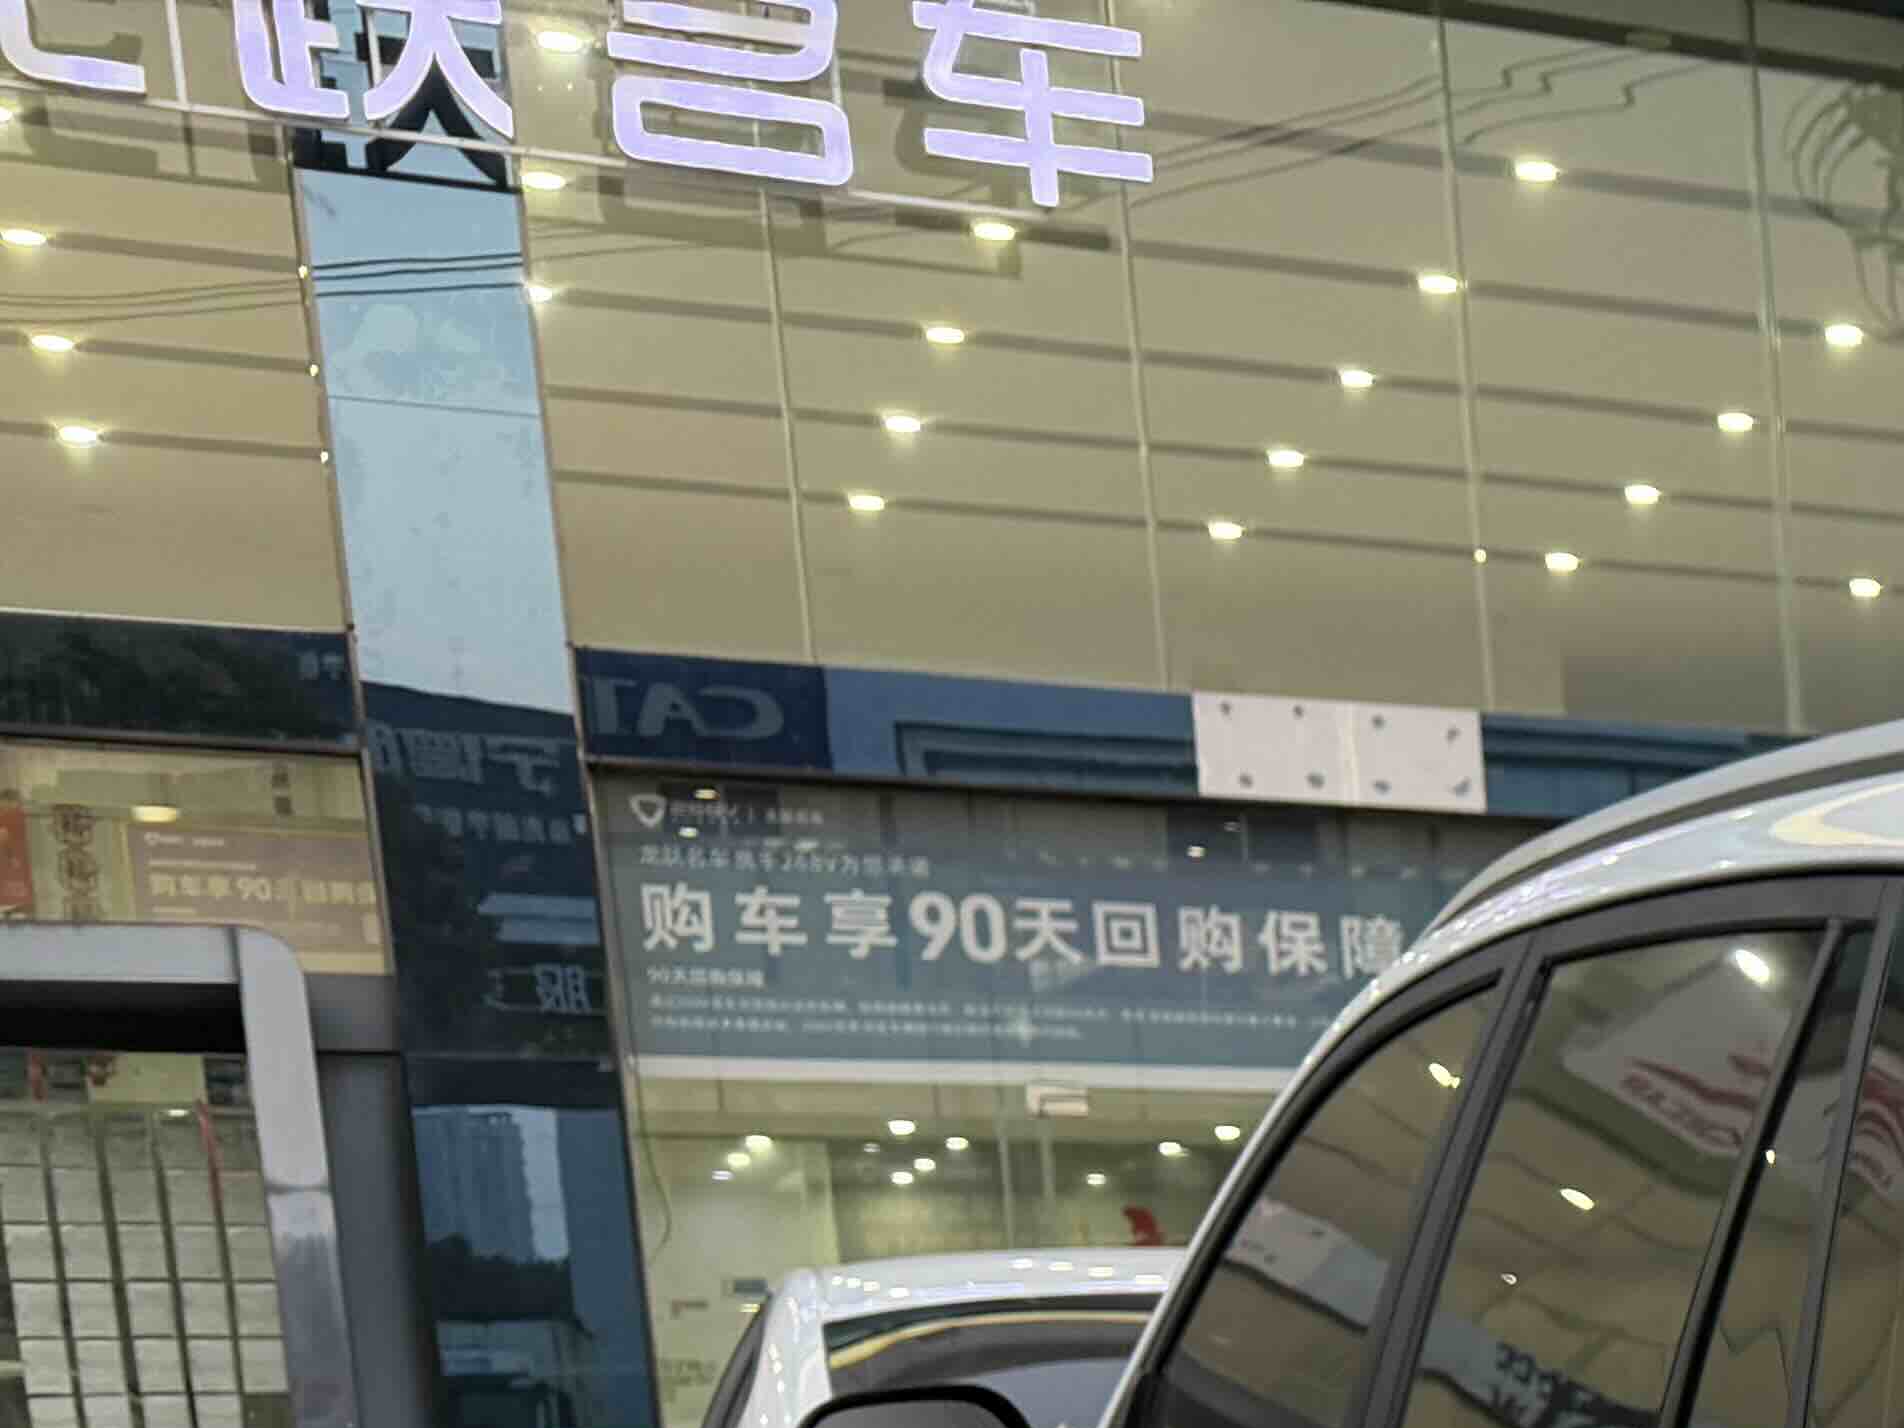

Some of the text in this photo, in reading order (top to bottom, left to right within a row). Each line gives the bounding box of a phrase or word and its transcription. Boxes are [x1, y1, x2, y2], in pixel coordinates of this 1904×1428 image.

[640, 881, 1403, 979] 购车享90天回购保障
